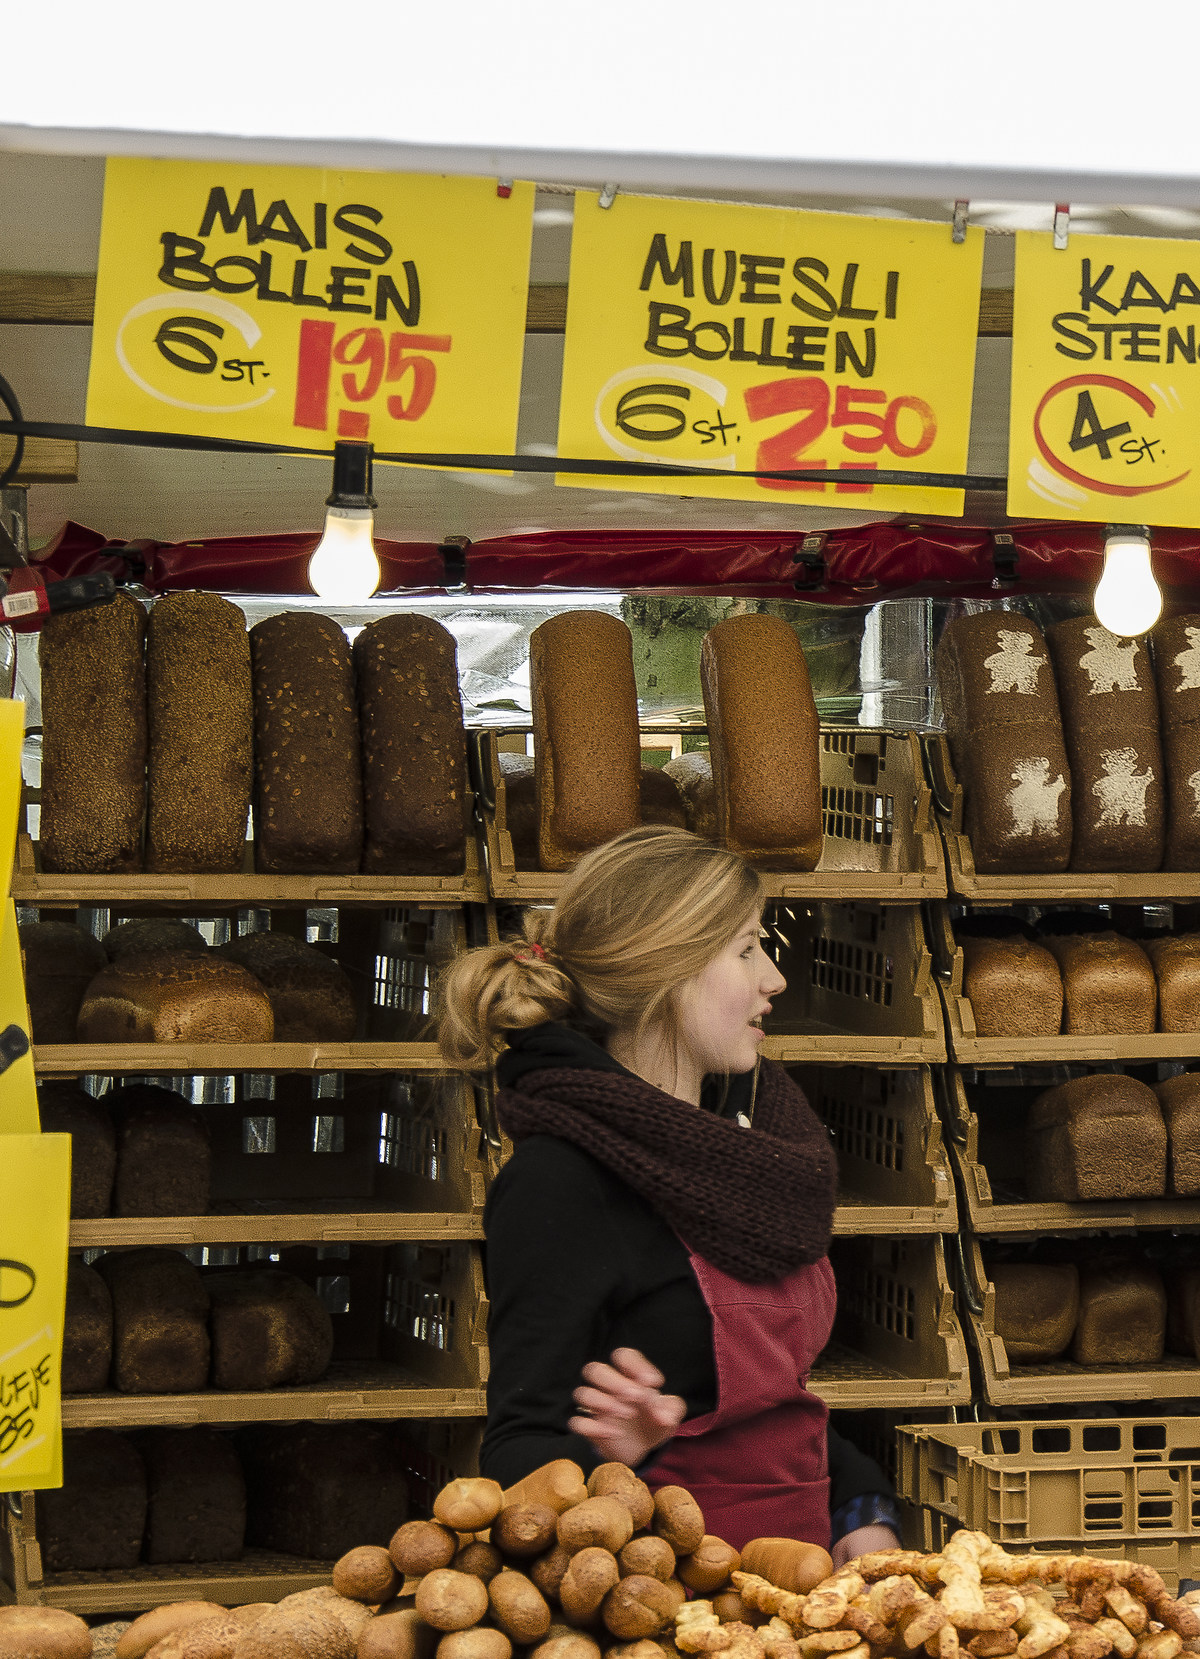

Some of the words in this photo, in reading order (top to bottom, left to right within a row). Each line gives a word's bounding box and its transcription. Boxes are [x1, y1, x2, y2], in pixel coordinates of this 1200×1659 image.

[198, 185, 394, 266] MAIS
[157, 231, 422, 328] BOLLEN
[638, 232, 900, 322] MUESLI
[152, 315, 225, 375] 6
[643, 300, 878, 379] BOLLEN
[615, 383, 691, 442] 6
[1068, 389, 1132, 461] 4
